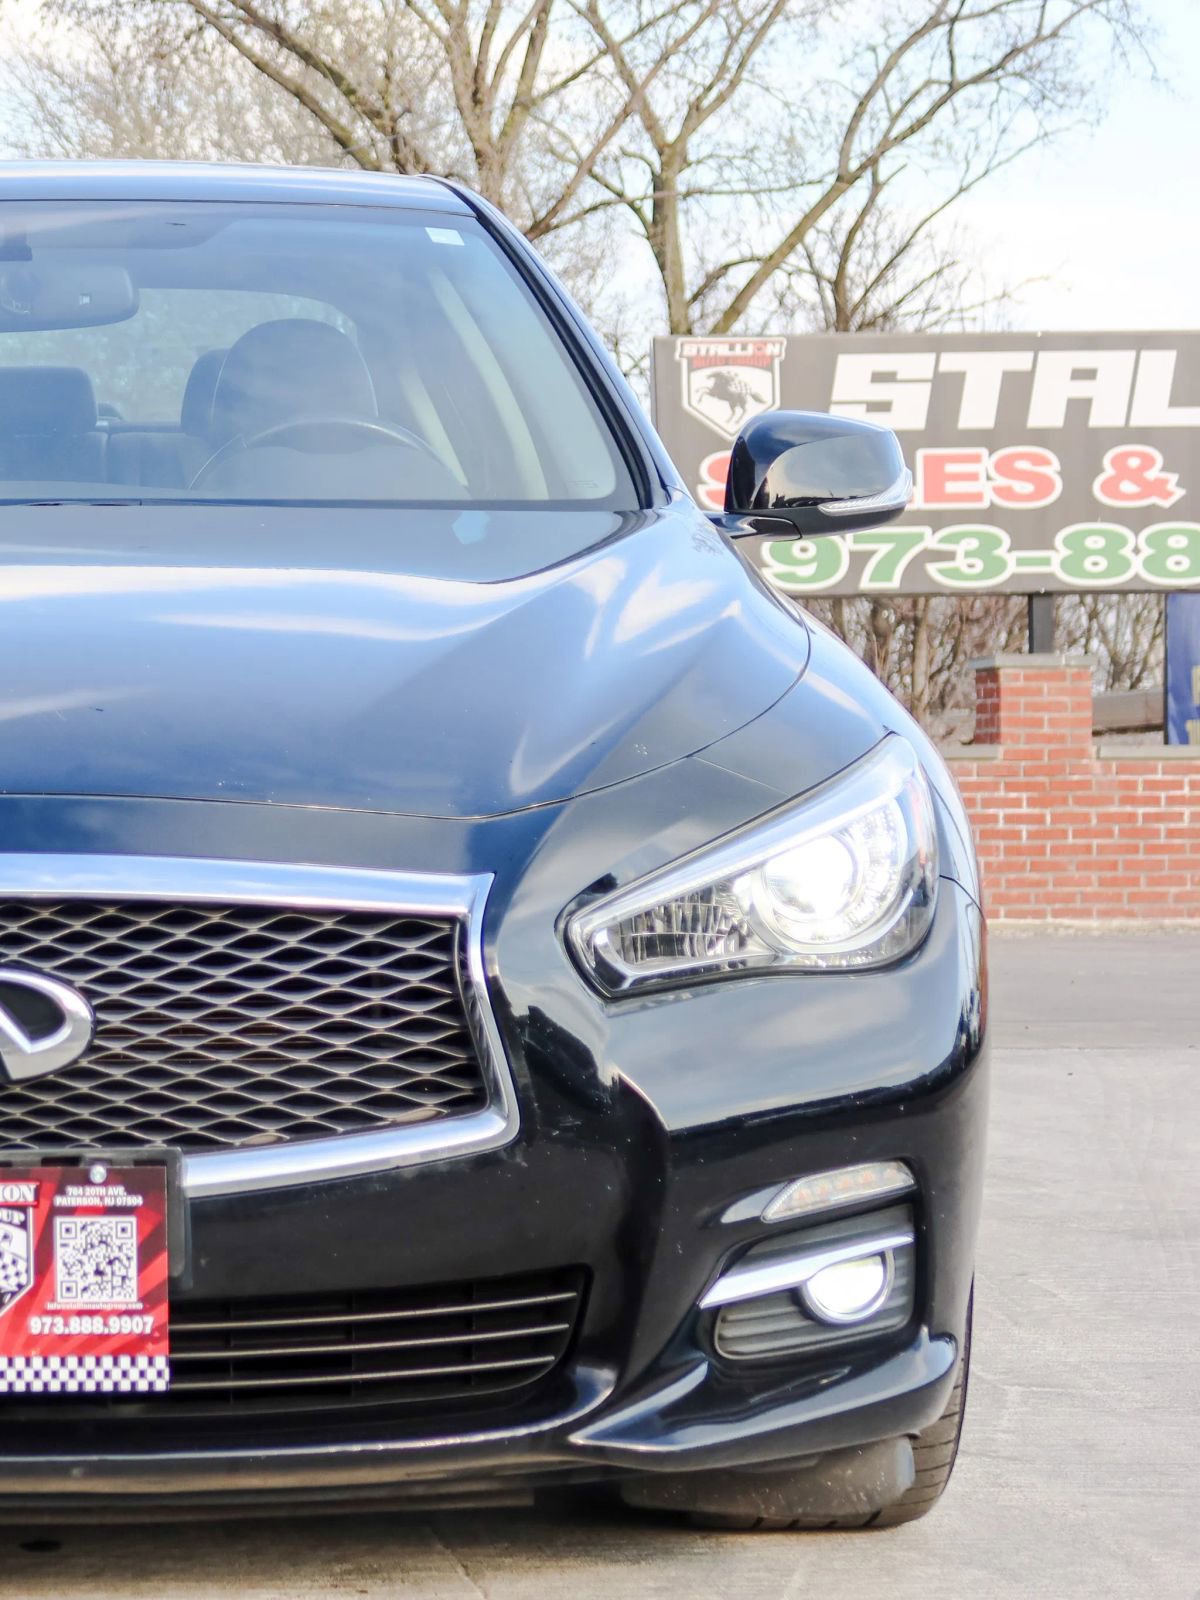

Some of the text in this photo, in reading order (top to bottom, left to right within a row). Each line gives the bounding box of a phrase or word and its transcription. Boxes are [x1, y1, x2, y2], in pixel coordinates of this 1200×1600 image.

[682, 343, 781, 357] STALLION
[1093, 444, 1187, 510] &
[761, 521, 1200, 592] 973-88
[28, 1315, 155, 1335] 973.888.9907
